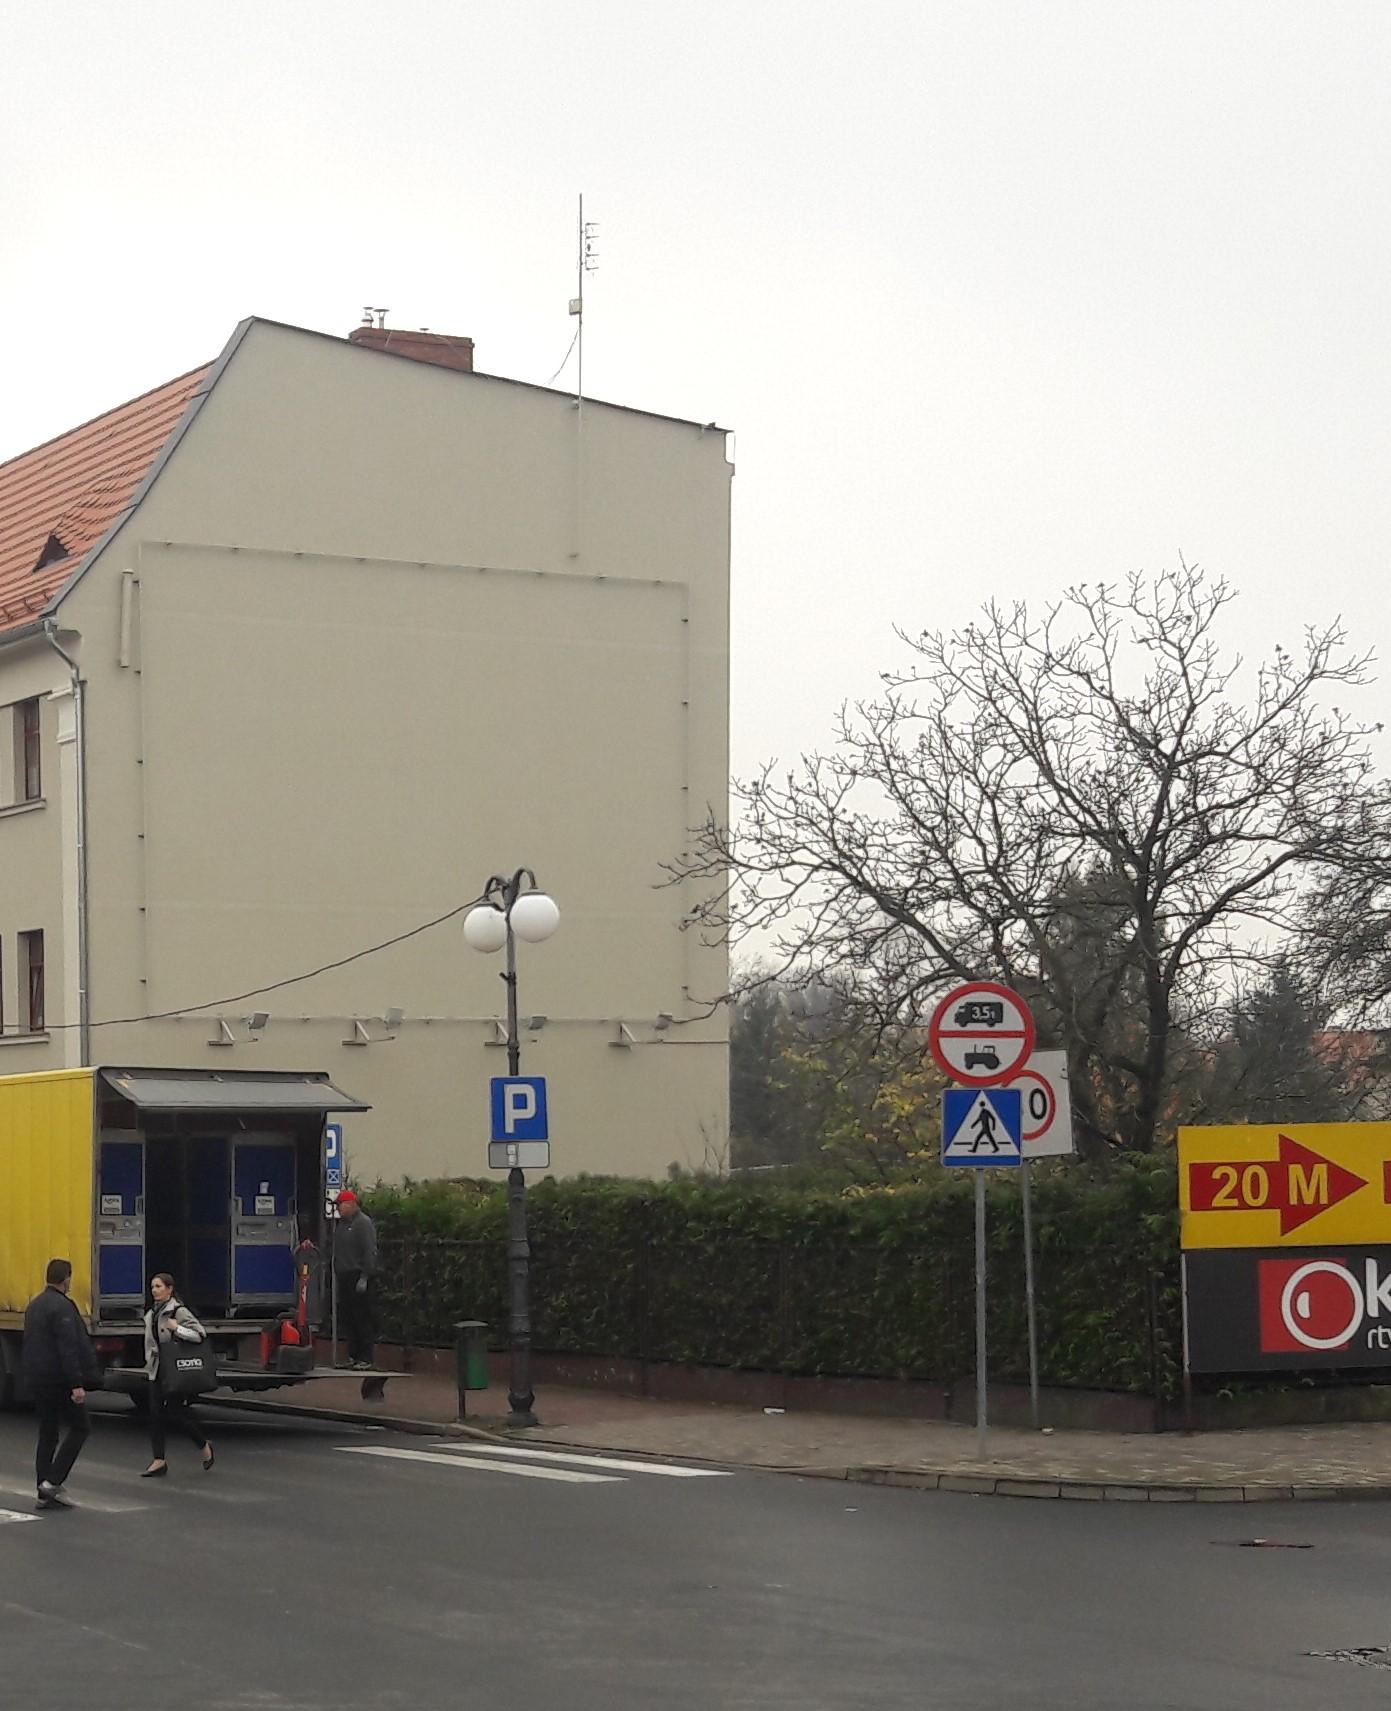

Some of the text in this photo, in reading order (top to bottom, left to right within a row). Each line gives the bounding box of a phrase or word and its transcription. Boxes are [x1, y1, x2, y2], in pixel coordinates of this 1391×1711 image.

[504, 1084, 536, 1134] P
[1029, 1088, 1047, 1120] 0
[1211, 1163, 1329, 1208] 20 M
